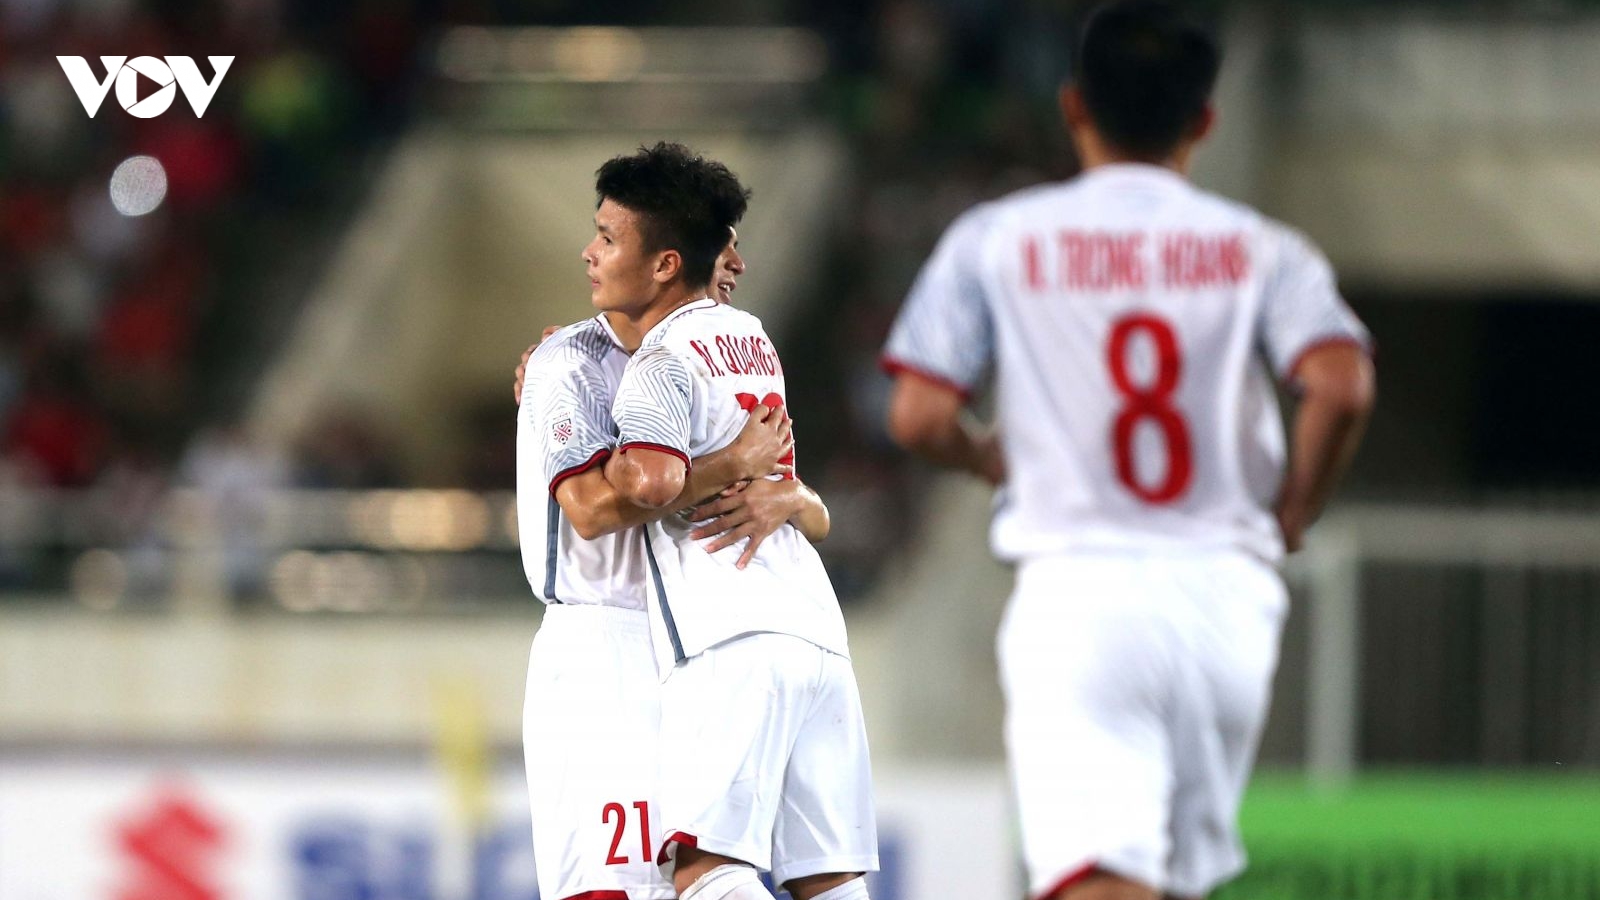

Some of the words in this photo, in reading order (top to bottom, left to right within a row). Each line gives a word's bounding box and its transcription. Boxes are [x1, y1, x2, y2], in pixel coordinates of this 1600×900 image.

[690, 340, 725, 377] N.
[716, 334, 775, 376] QUANG
[1106, 312, 1193, 506] 8
[602, 800, 652, 865] 21
